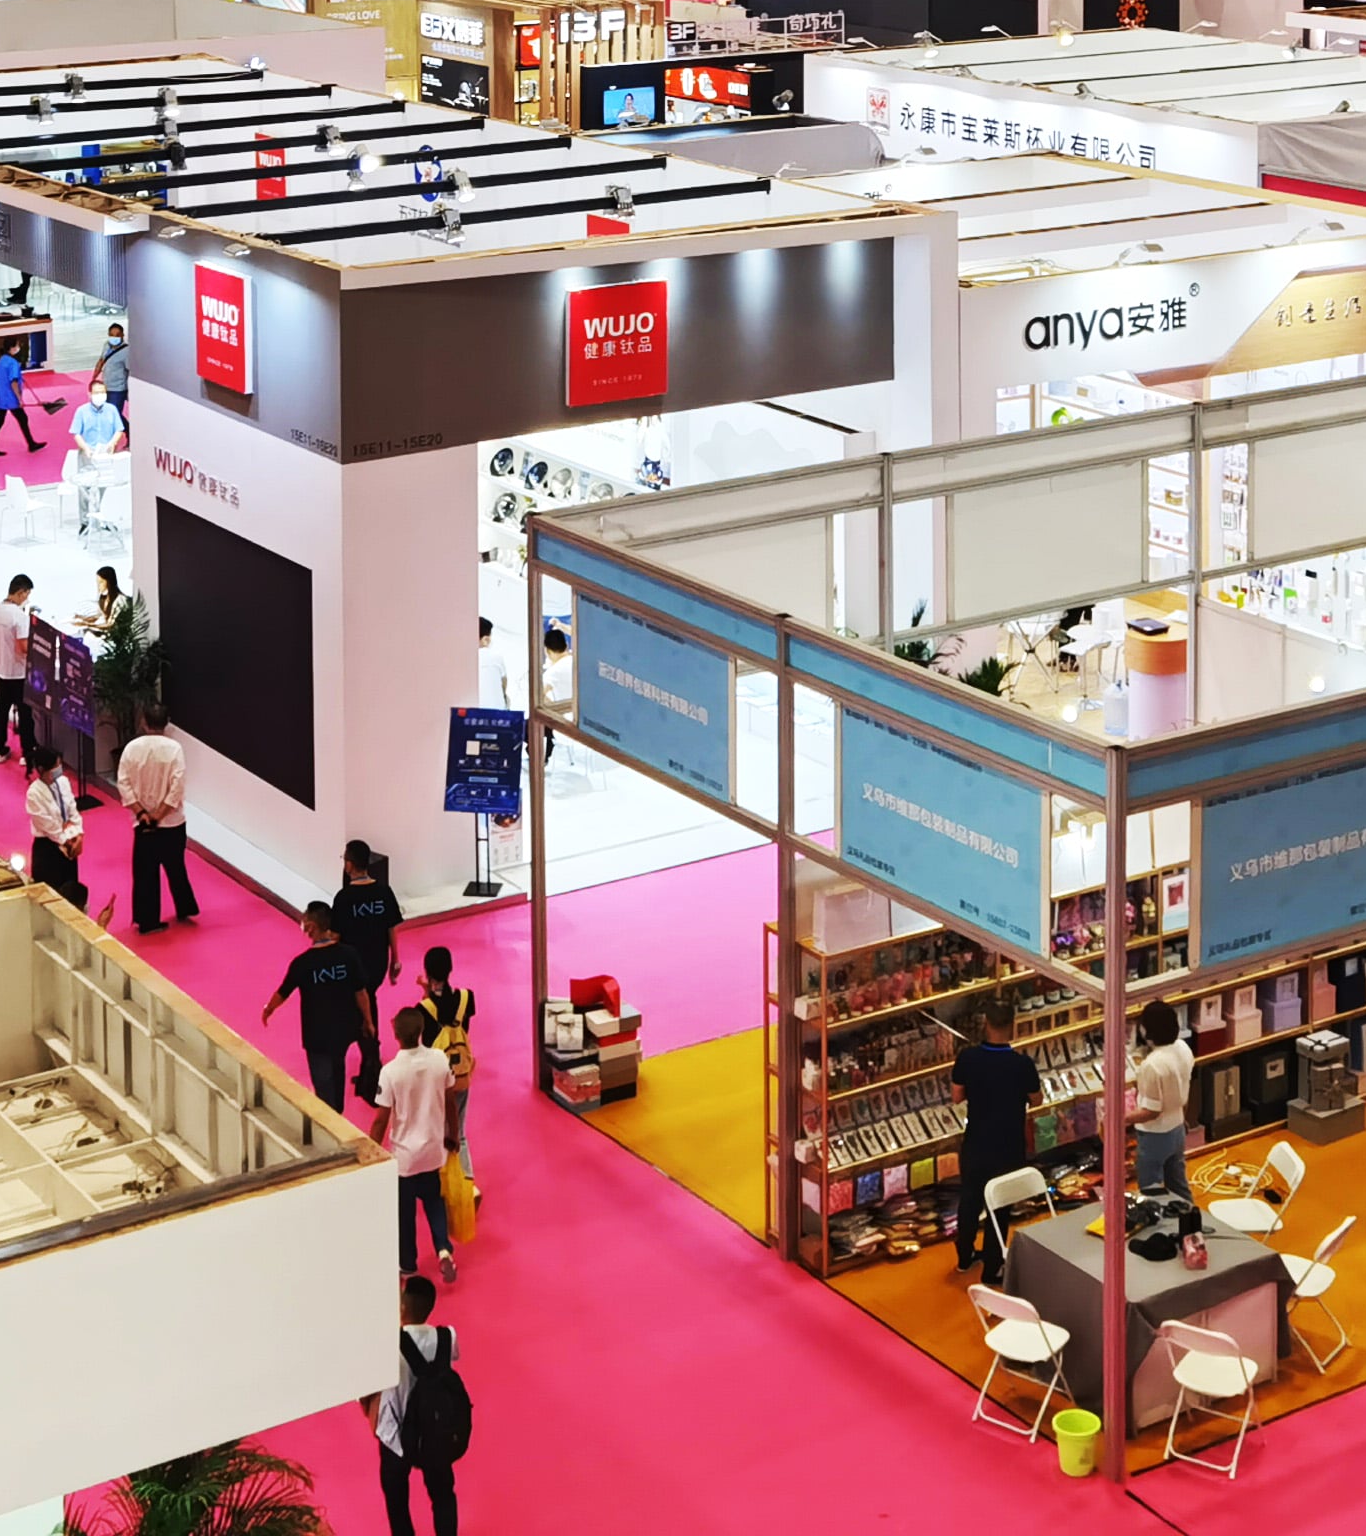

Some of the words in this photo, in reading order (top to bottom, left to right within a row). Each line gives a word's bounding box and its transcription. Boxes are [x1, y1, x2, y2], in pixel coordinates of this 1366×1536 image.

[201, 294, 239, 326] WUJO
[1024, 306, 1124, 352] anya
[1128, 296, 1188, 338] 安雅
[201, 320, 239, 347] 健康钛品
[584, 312, 655, 340] WUJO
[584, 336, 653, 361] 健康钛品
[352, 432, 443, 457] 15E11-15E20
[153, 445, 194, 486] WUJO
